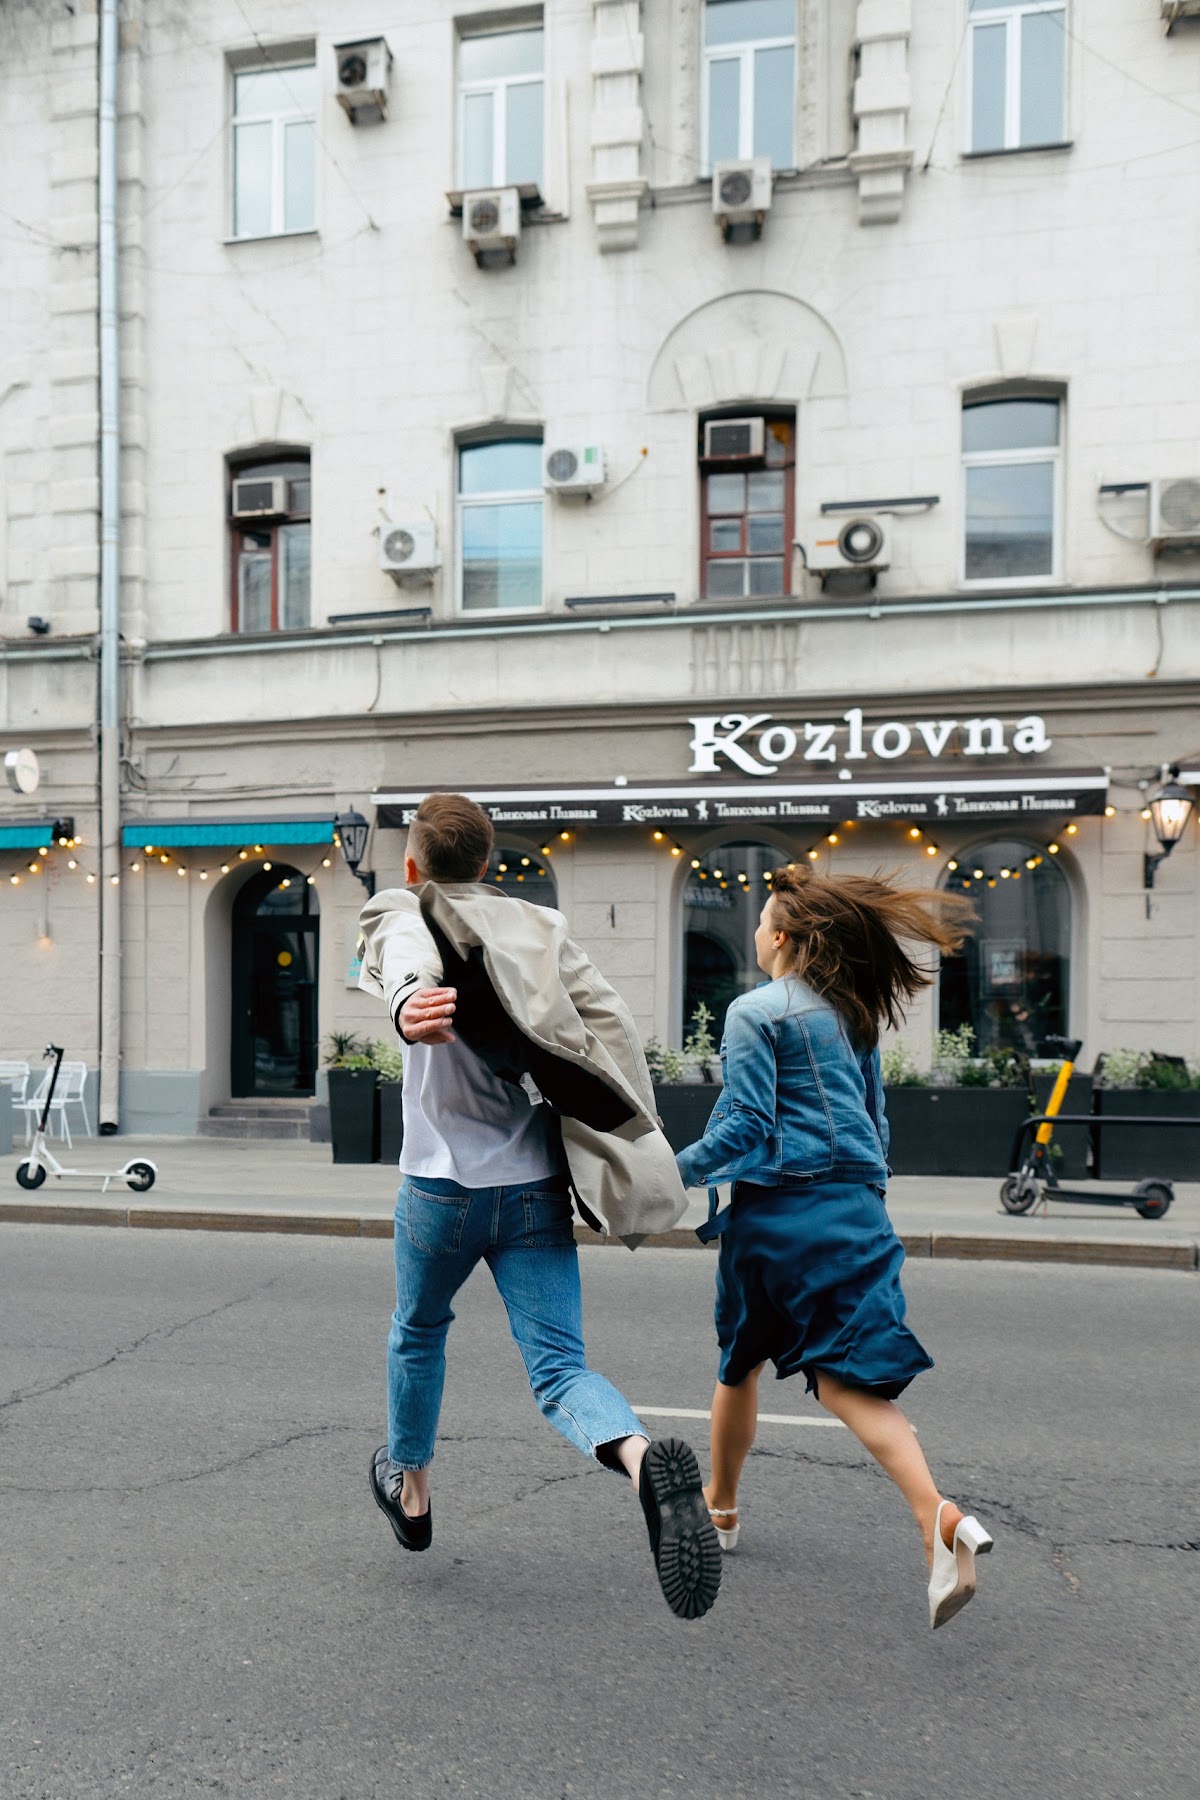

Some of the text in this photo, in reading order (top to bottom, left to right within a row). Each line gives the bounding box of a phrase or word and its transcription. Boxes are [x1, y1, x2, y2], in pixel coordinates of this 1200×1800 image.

[688, 708, 1052, 775] Kozlovna
[714, 801, 831, 817] Танковая Пивная
[856, 799, 927, 818] Kozlovna
[953, 795, 1076, 813] Танковая Пивная
[489, 805, 598, 821] Танковая Пивная
[622, 805, 689, 822] Kozlovna
